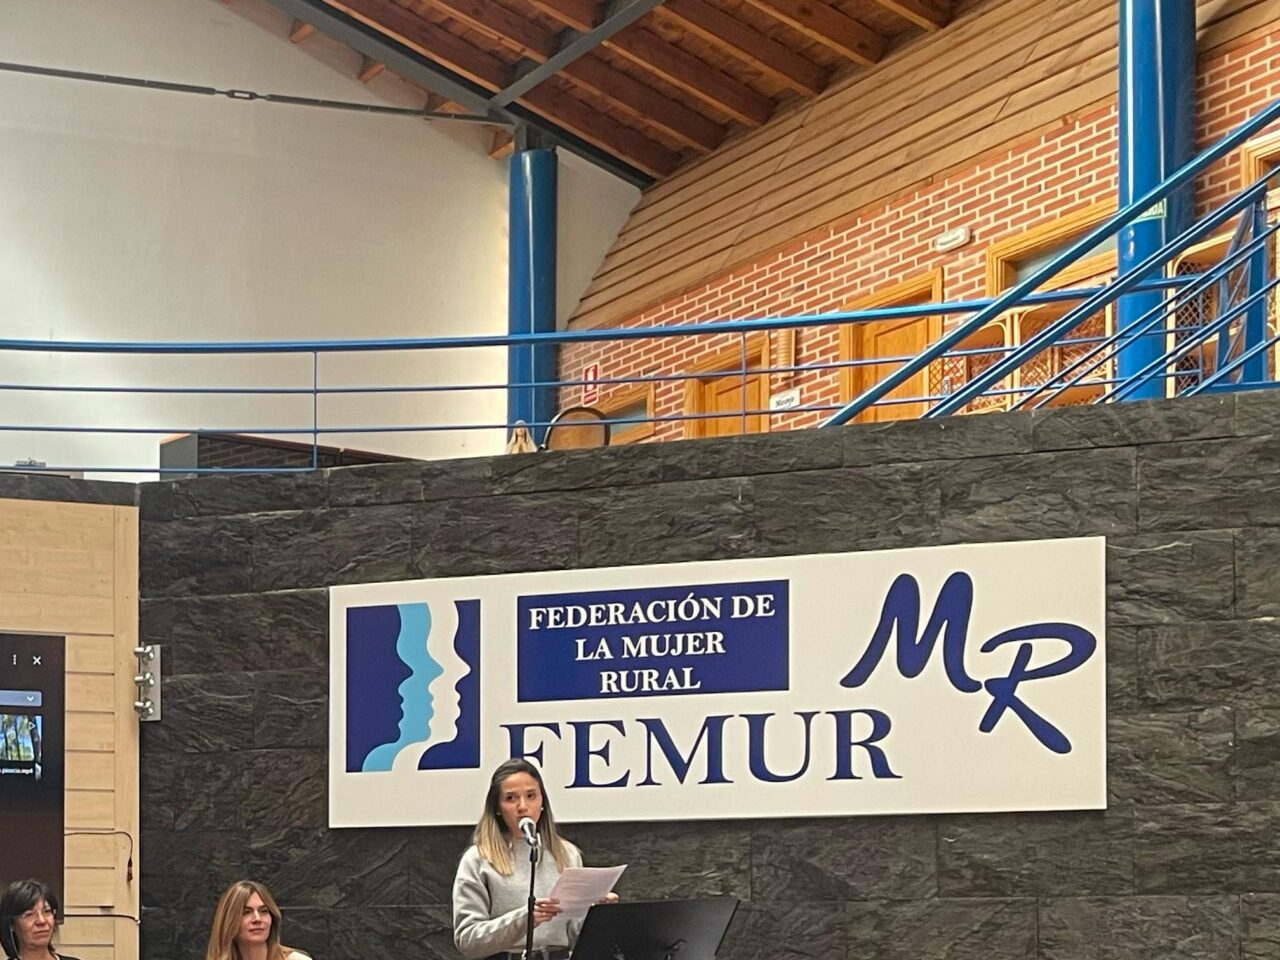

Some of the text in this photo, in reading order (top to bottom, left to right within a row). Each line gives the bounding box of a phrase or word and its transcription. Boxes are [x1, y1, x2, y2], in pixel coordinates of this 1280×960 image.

[528, 592, 776, 630] FEDERACIÓN DE
[574, 630, 727, 662] LA MUJER
[599, 666, 702, 694] RURAL
[499, 707, 904, 790] FEMUR
